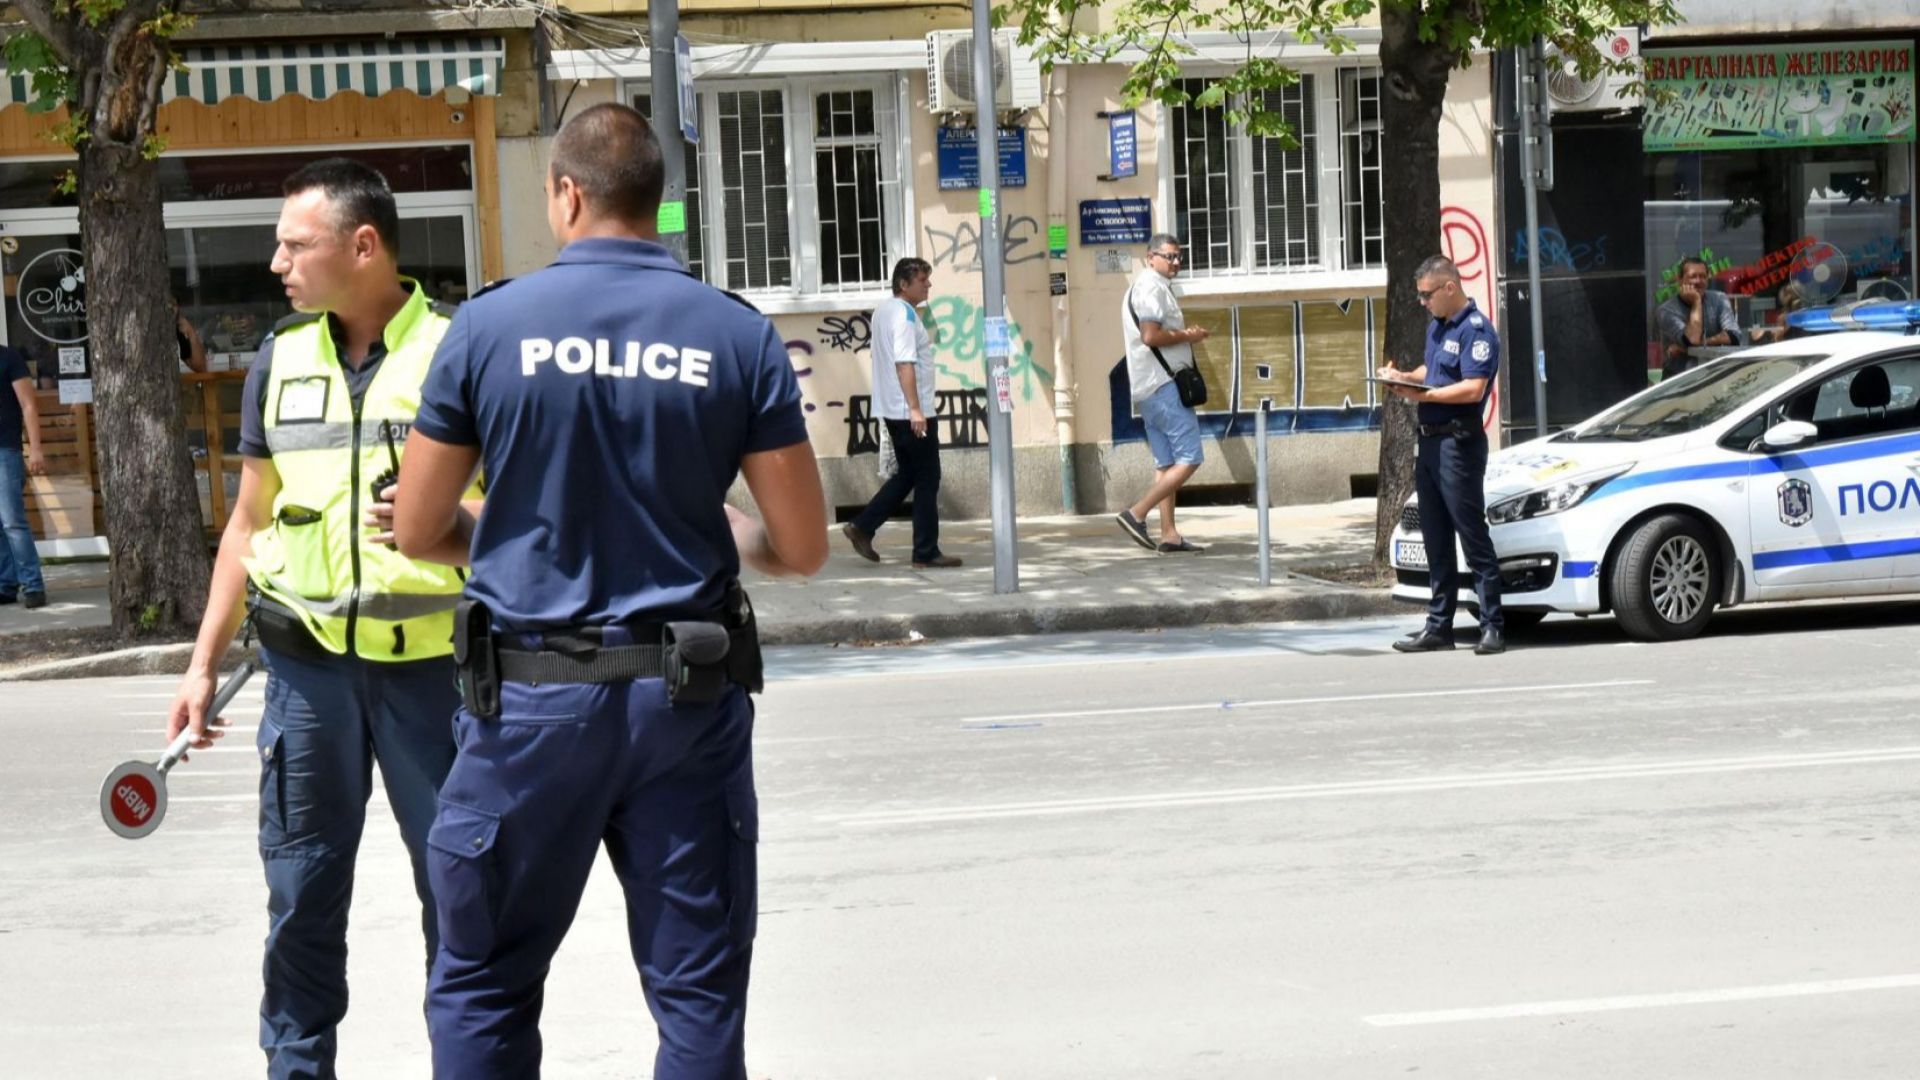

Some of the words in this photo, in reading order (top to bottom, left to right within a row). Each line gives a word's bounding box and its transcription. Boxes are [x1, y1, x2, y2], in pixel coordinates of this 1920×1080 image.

[1784, 49, 1910, 77] ЖЕЛЕЗАРИЯ
[924, 214, 1046, 266] DAE
[26, 287, 87, 314] Chir
[520, 336, 712, 387] POLICE
[380, 424, 408, 439] POL
[1838, 477, 1920, 516] ПОЛ
[117, 785, 151, 820] МВР
